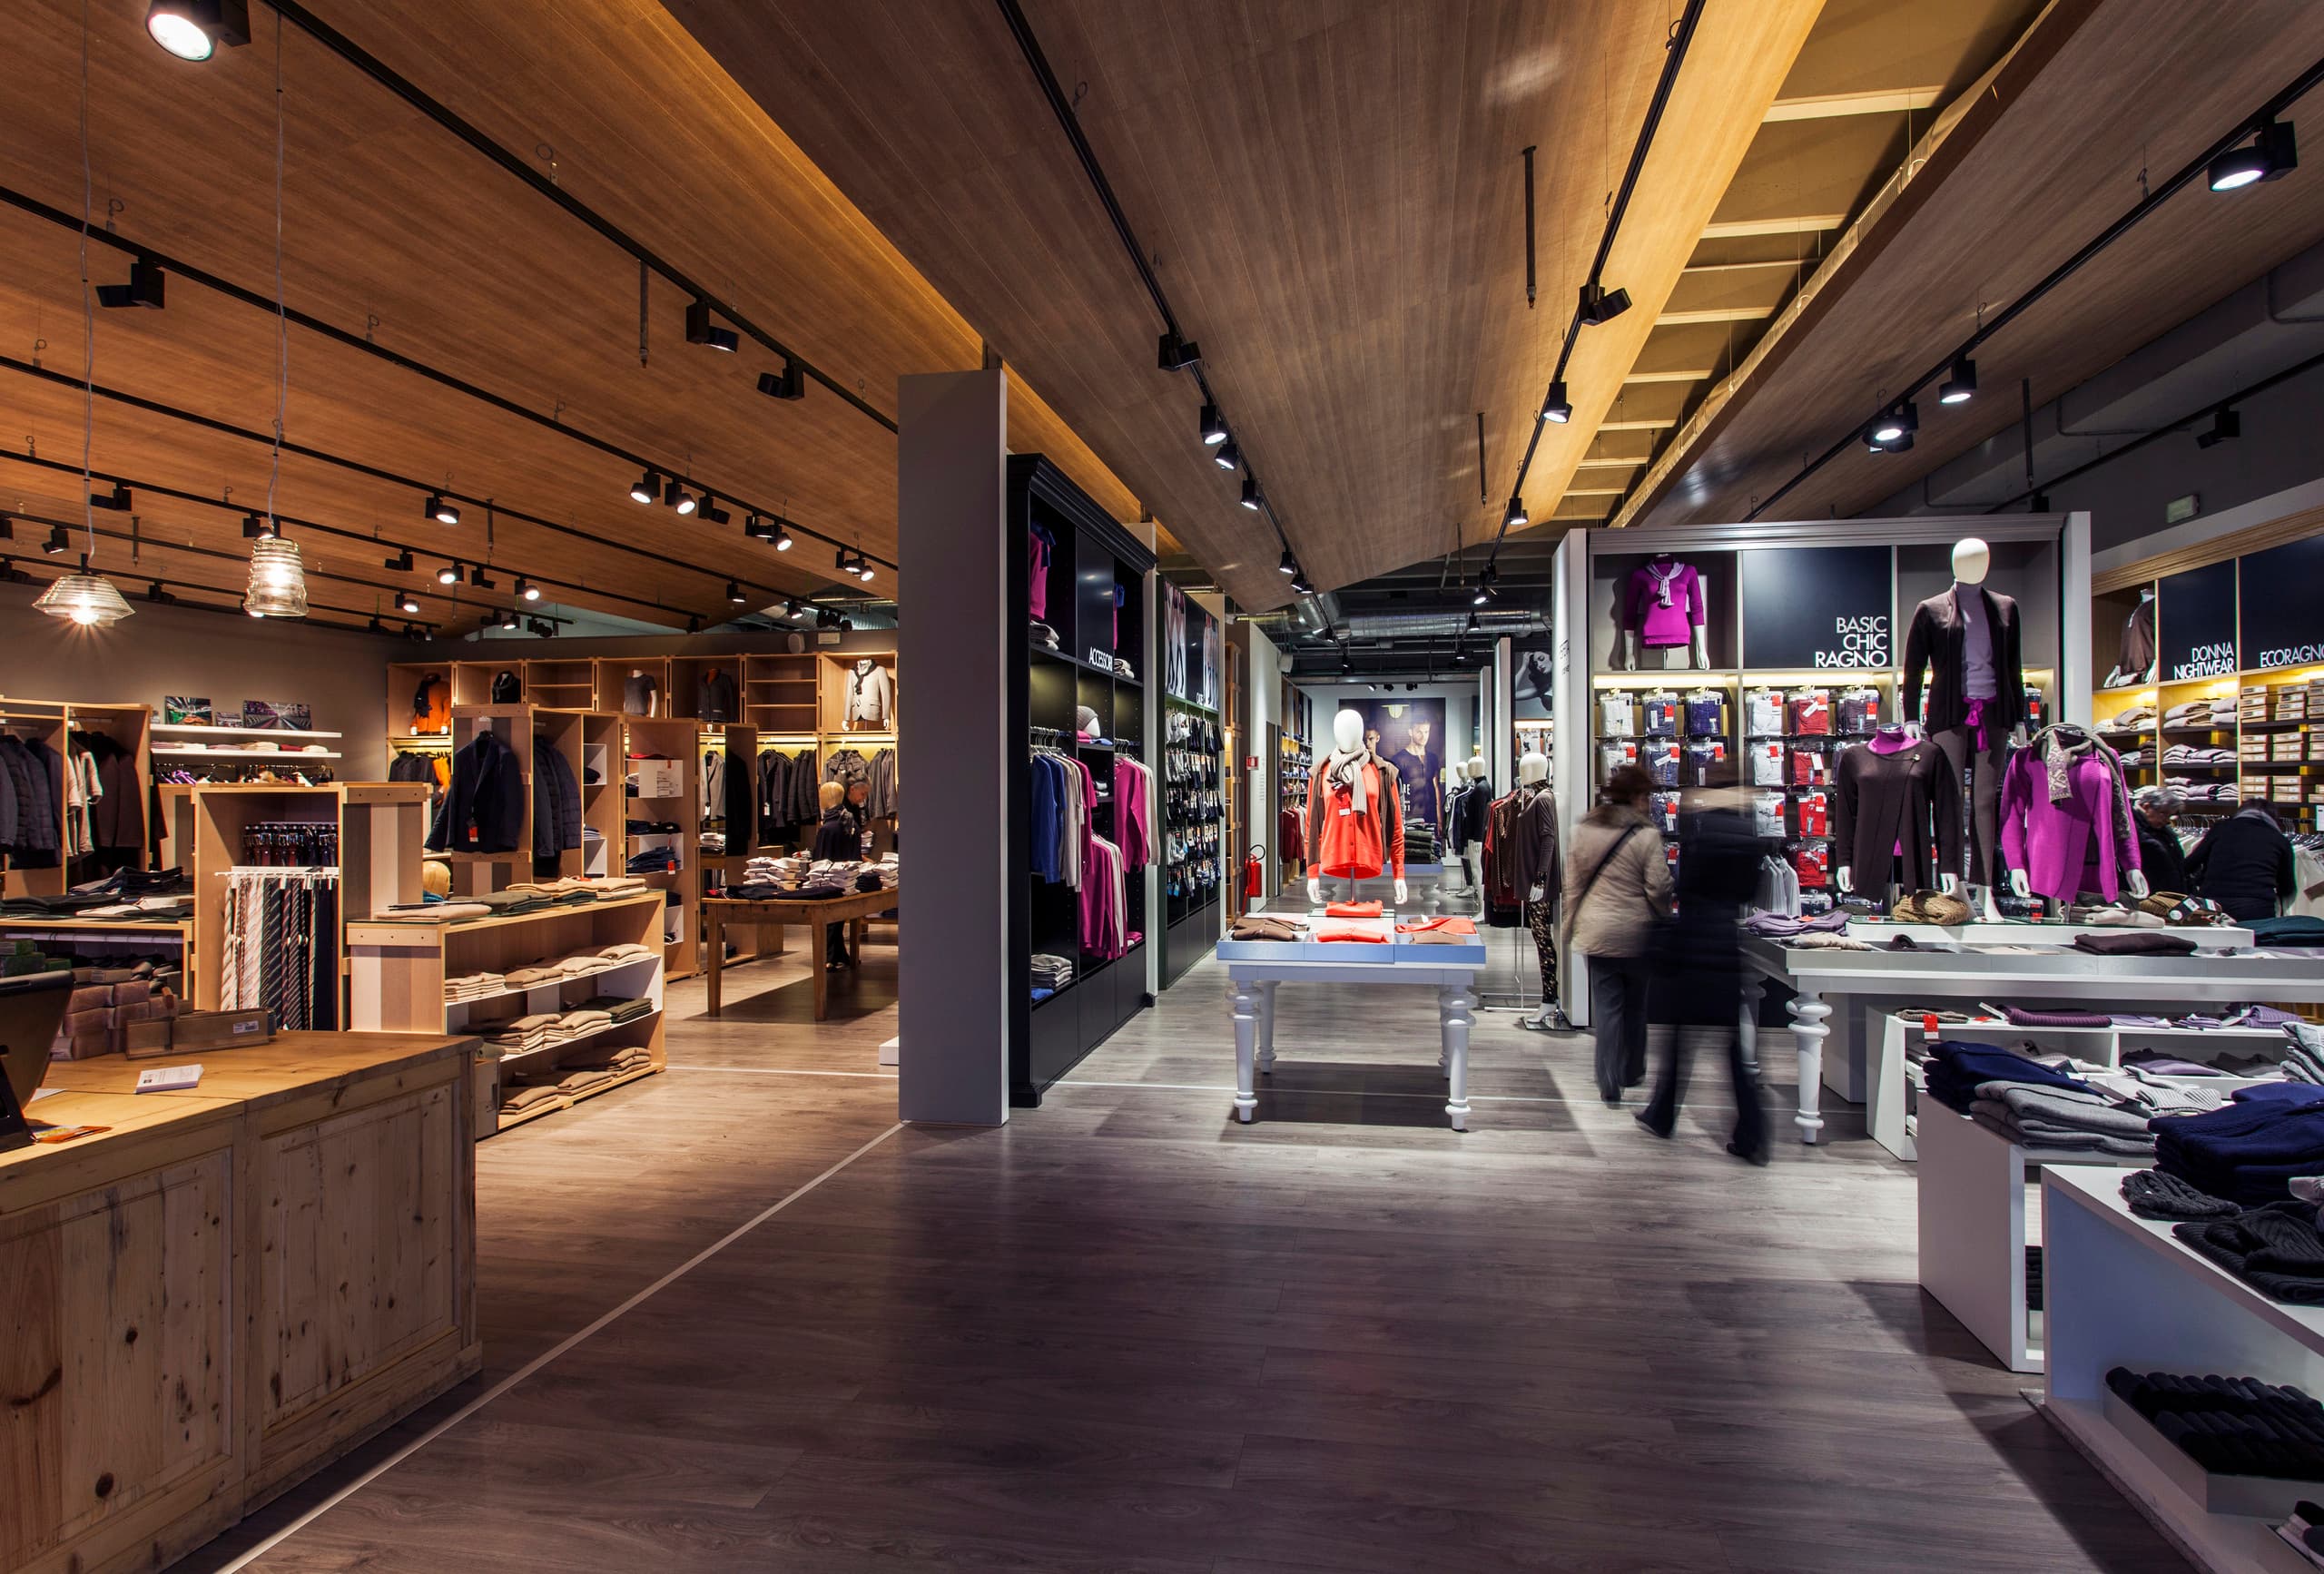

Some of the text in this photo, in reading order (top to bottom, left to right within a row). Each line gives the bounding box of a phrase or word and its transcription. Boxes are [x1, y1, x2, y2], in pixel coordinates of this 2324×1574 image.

[1836, 616, 1887, 634] BASIC
[1843, 634, 1887, 650] CHIC
[2191, 641, 2234, 663] DONNA
[1089, 645, 1113, 672] ACCESSORI
[1815, 650, 1887, 668] RAGNO
[2174, 657, 2235, 680] NIGHTWEAR
